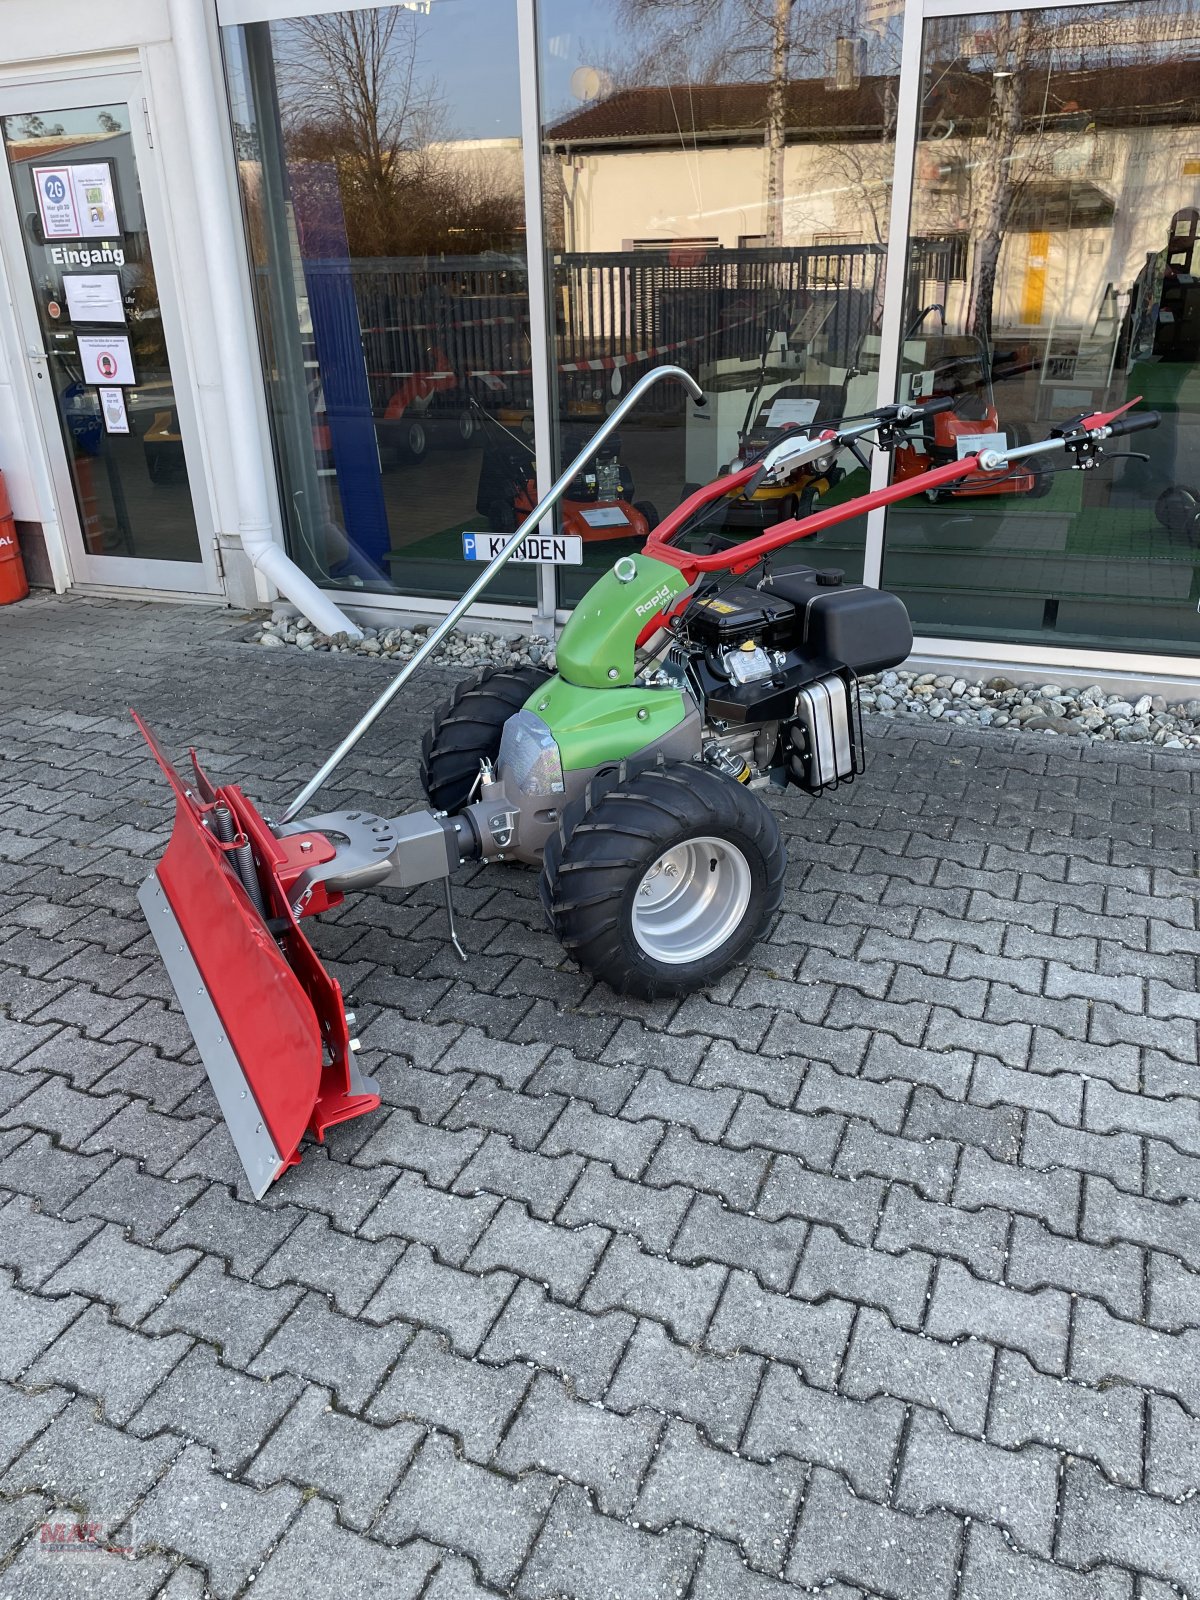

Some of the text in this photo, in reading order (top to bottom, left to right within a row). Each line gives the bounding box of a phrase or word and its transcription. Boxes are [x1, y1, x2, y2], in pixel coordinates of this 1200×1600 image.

[47, 181, 63, 198] 2G
[51, 247, 125, 268] Eingang
[464, 538, 475, 555] P
[634, 584, 670, 617] Rapid
